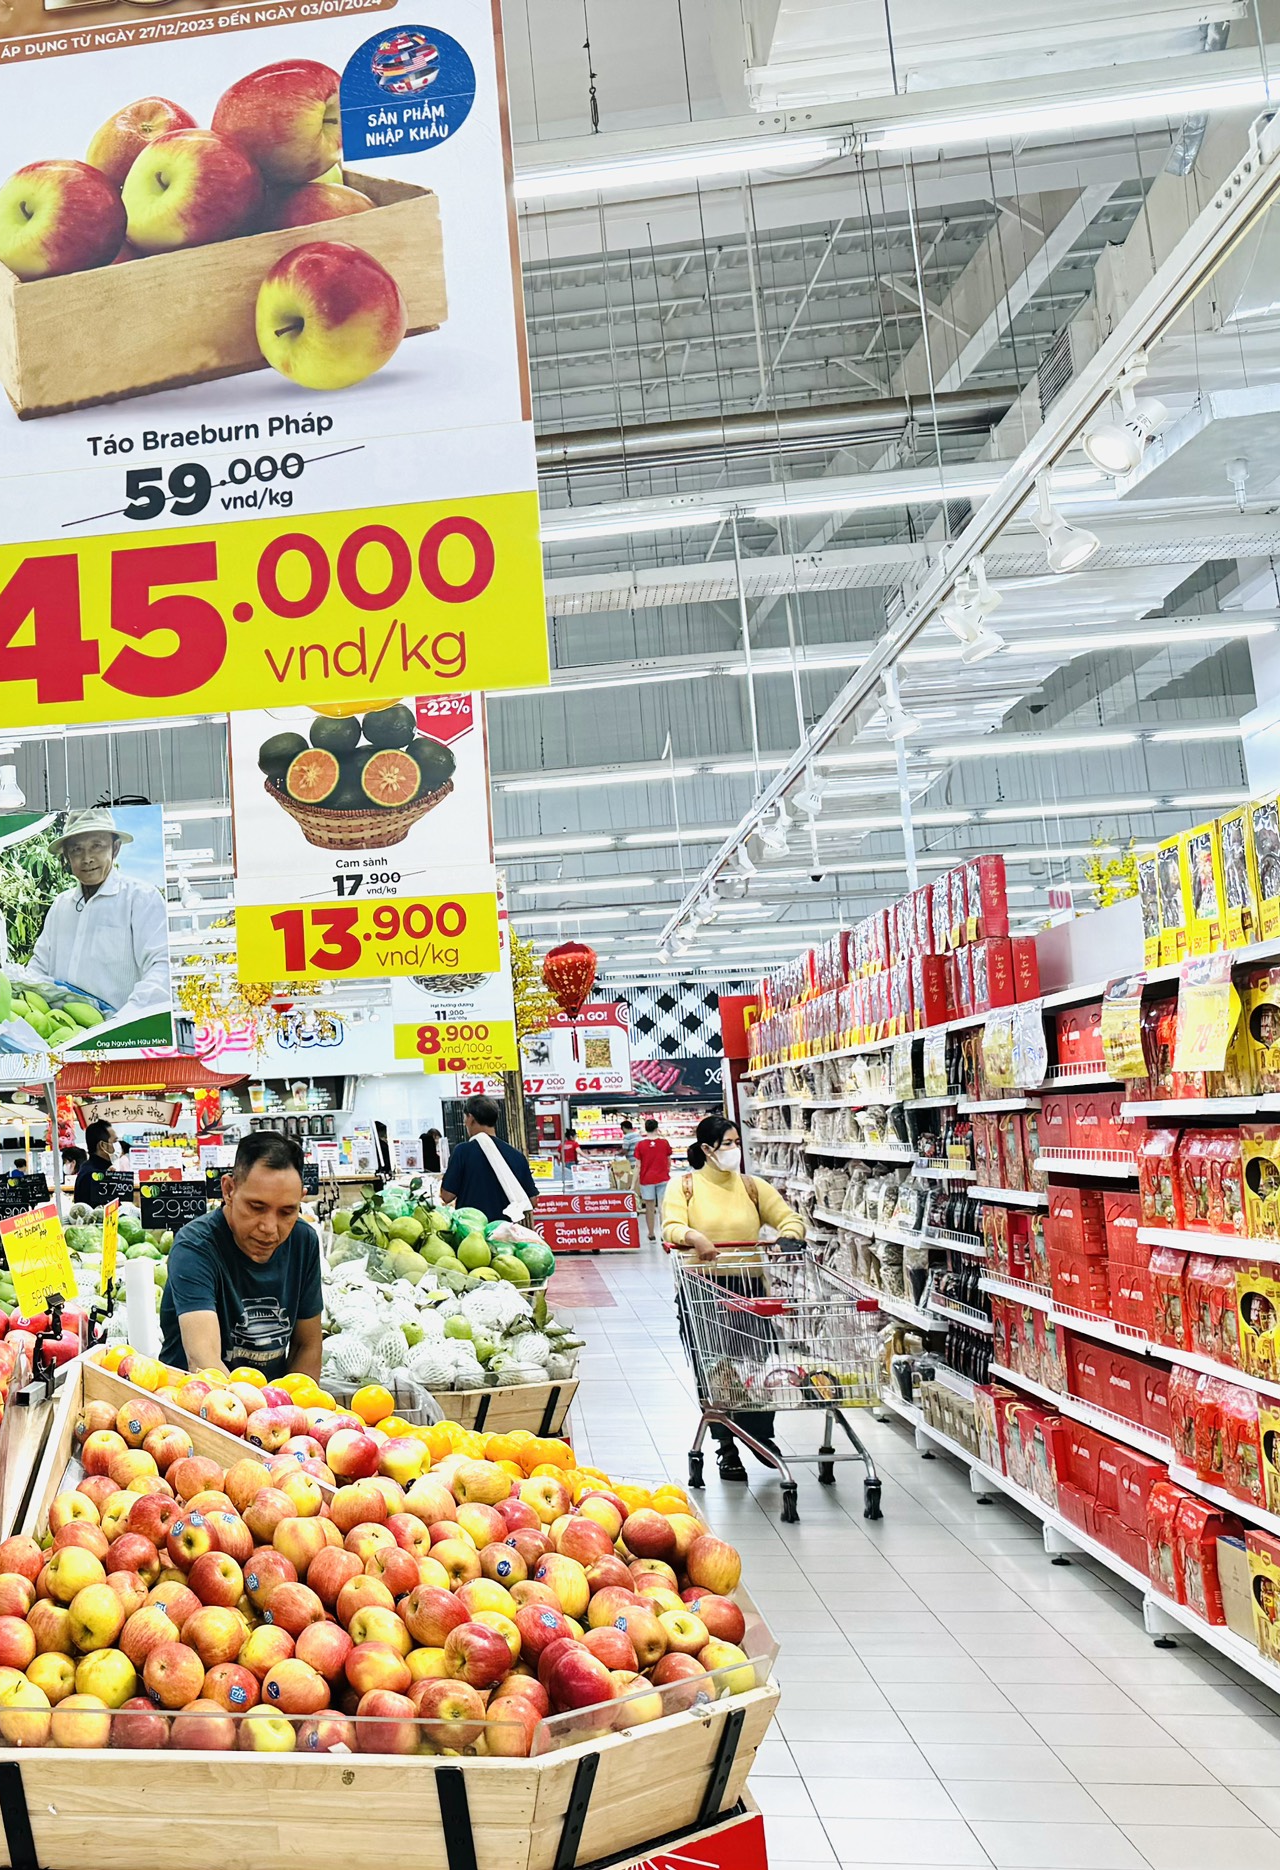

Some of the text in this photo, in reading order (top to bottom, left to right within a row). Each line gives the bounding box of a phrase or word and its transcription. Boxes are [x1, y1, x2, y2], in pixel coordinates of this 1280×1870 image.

[0, 4, 297, 59] ÁP DỤNG TỪ NGÀY 27/12/2023 ĐẾN NGÀY
[368, 100, 445, 127] SẢN PHẨM
[366, 122, 449, 147] NHẬP KHẨU
[88, 410, 334, 458] Táo Braeburn Pháp
[124, 452, 304, 521] 59.000
[220, 487, 294, 512] vnd/kg
[264, 619, 467, 684] vnd/kg
[420, 699, 470, 717] -22%
[336, 857, 388, 868] Cam sành
[332, 872, 401, 896] 17.900
[366, 886, 397, 895] vnd/kg
[270, 901, 467, 972] 13.900
[376, 944, 459, 969] vnd/kg
[435, 1010, 464, 1021] 11.900
[96, 1038, 110, 1048] Ông
[110, 1038, 136, 1048] Nguyễn
[151, 1038, 168, 1046] Minh
[416, 1024, 489, 1055] 8.900
[440, 1042, 492, 1054] vnd/100g
[466, 1061, 507, 1072] vnd/100g
[524, 1077, 566, 1092] 47.000
[576, 1076, 624, 1091] 64.000
[98, 1182, 134, 1196] 37.900
[152, 1199, 206, 1218] 29.900
